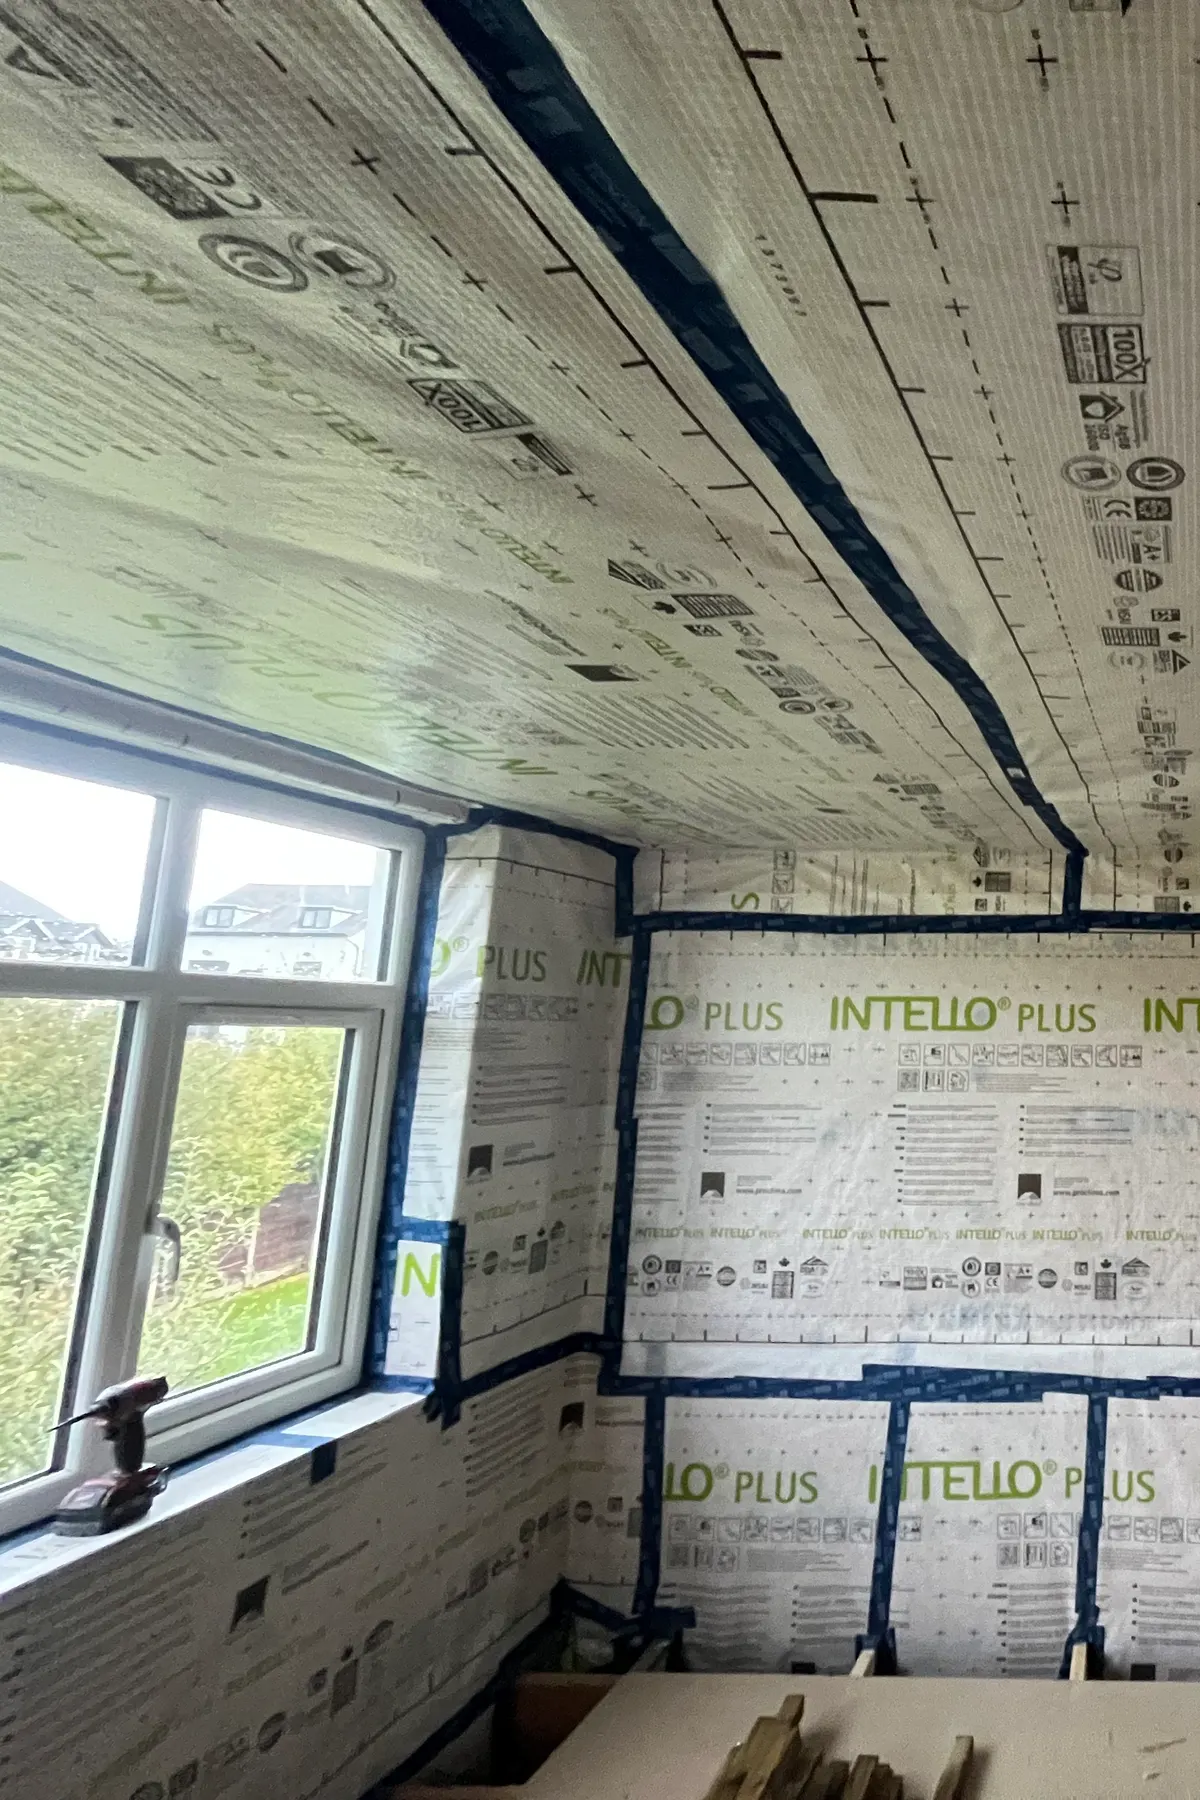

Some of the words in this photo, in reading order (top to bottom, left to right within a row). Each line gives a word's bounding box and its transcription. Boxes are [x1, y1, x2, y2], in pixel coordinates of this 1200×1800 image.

[1113, 329, 1139, 381] 100X
[1104, 500, 1131, 518] CE
[476, 944, 548, 982] PLUS
[704, 1001, 784, 1032] PLUS
[1018, 1003, 1097, 1033] PLUS
[986, 1277, 999, 1287] CE
[734, 1471, 818, 1504] PLUS
